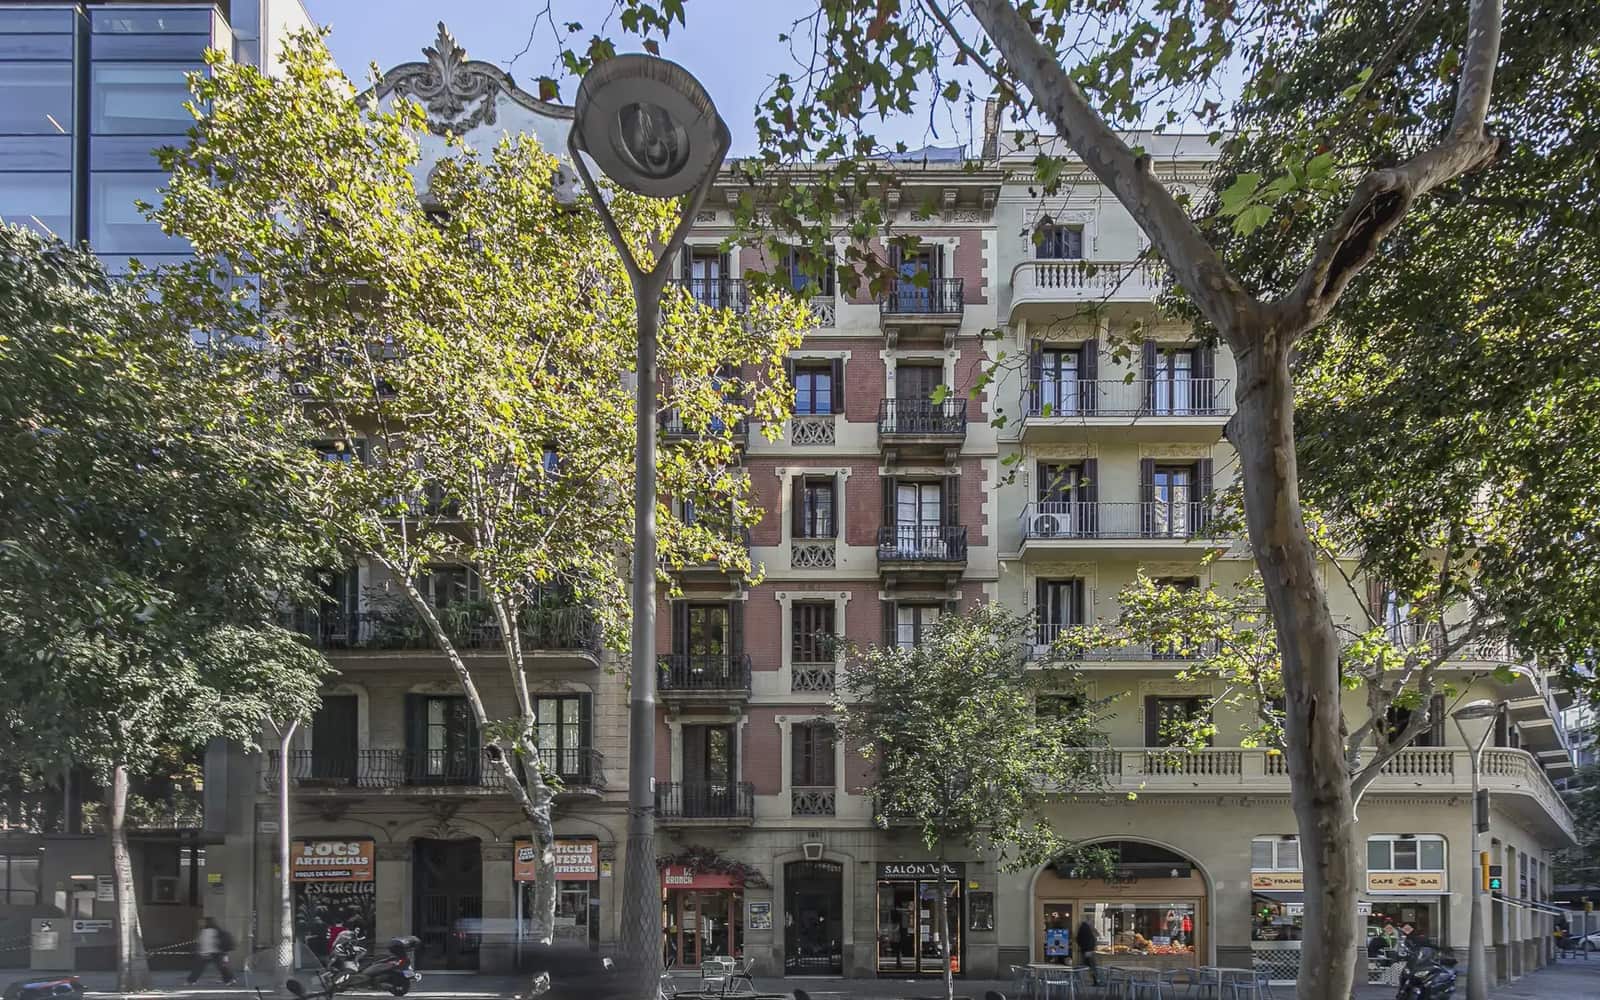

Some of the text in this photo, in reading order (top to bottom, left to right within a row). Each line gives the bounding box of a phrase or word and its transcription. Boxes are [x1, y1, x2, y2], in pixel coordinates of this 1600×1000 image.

[304, 842, 359, 855] FOCS
[554, 844, 593, 854] TICLES
[885, 864, 925, 874] SALÓN
[304, 881, 375, 894] Estalella
